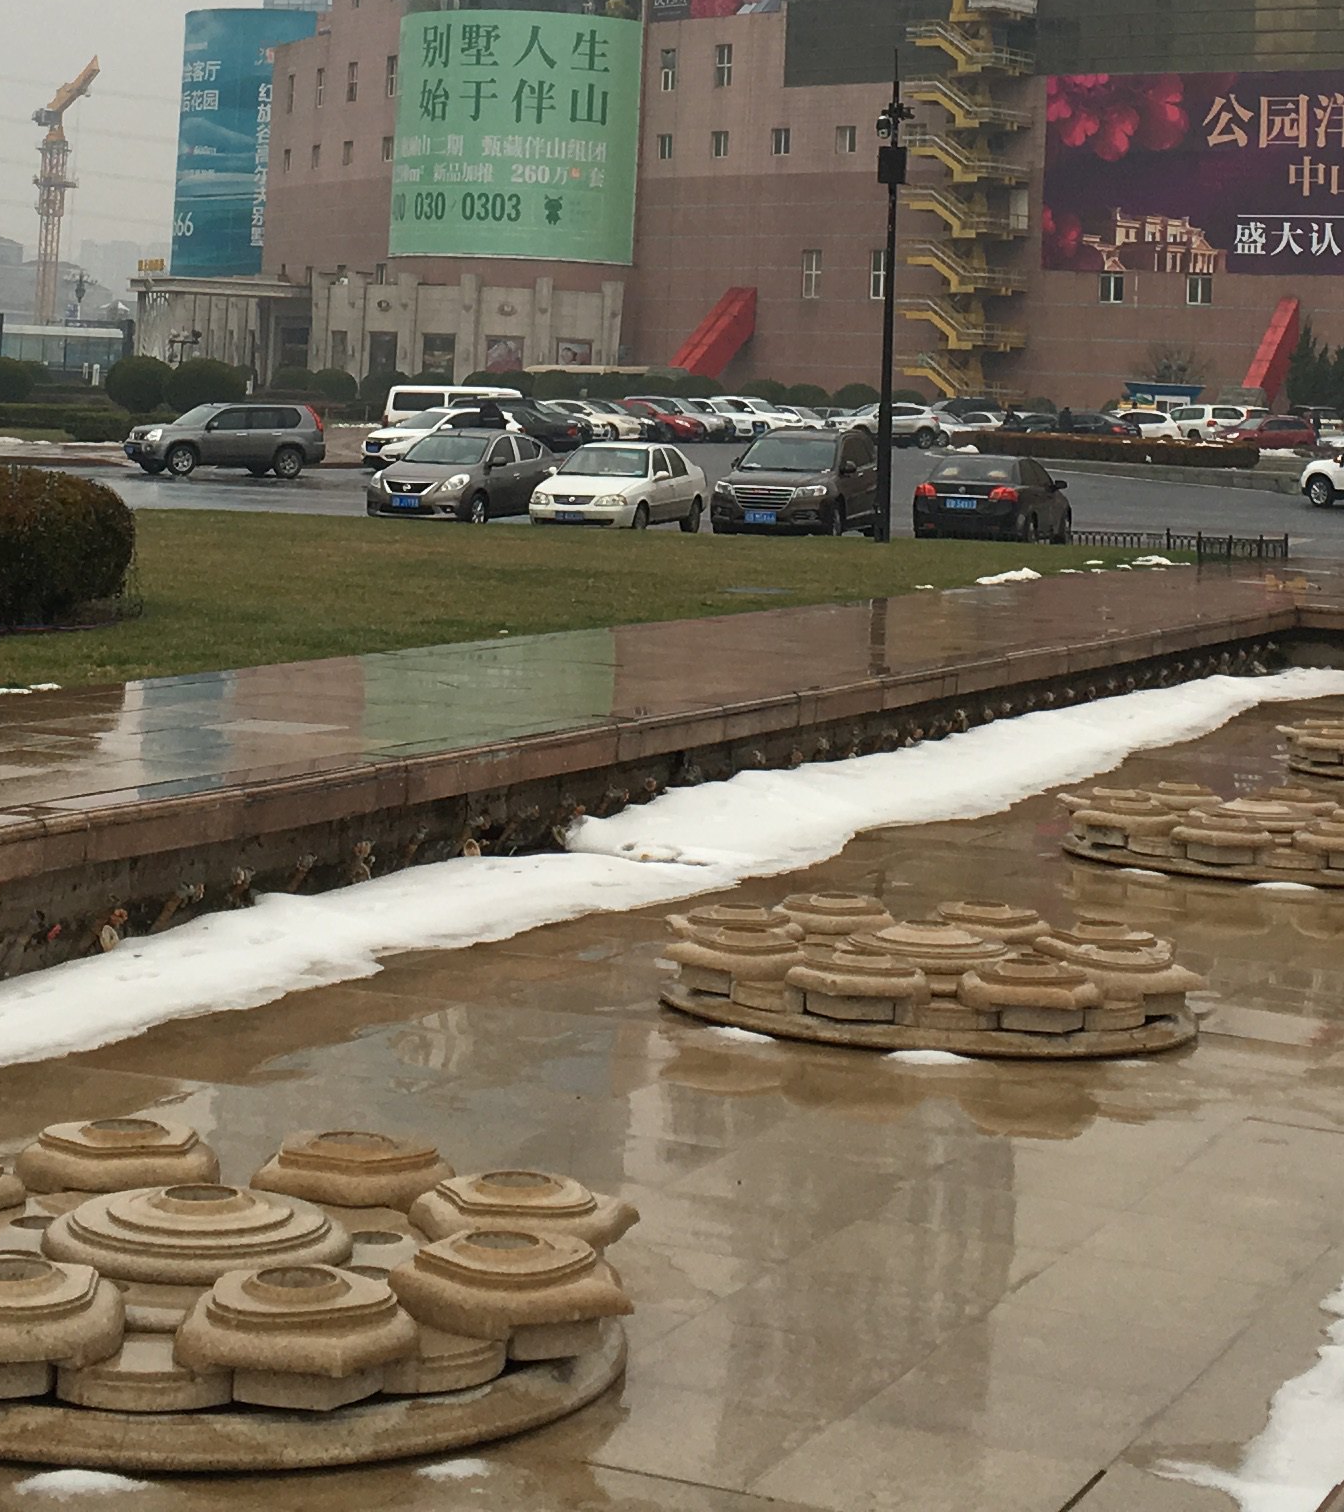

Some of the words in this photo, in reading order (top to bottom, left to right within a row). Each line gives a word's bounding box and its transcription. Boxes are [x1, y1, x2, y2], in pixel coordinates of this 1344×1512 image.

[421, 23, 610, 73] 别墅人生
[419, 78, 609, 126] 始于伴山
[414, 191, 446, 221] 030
[461, 192, 522, 222] 0303
